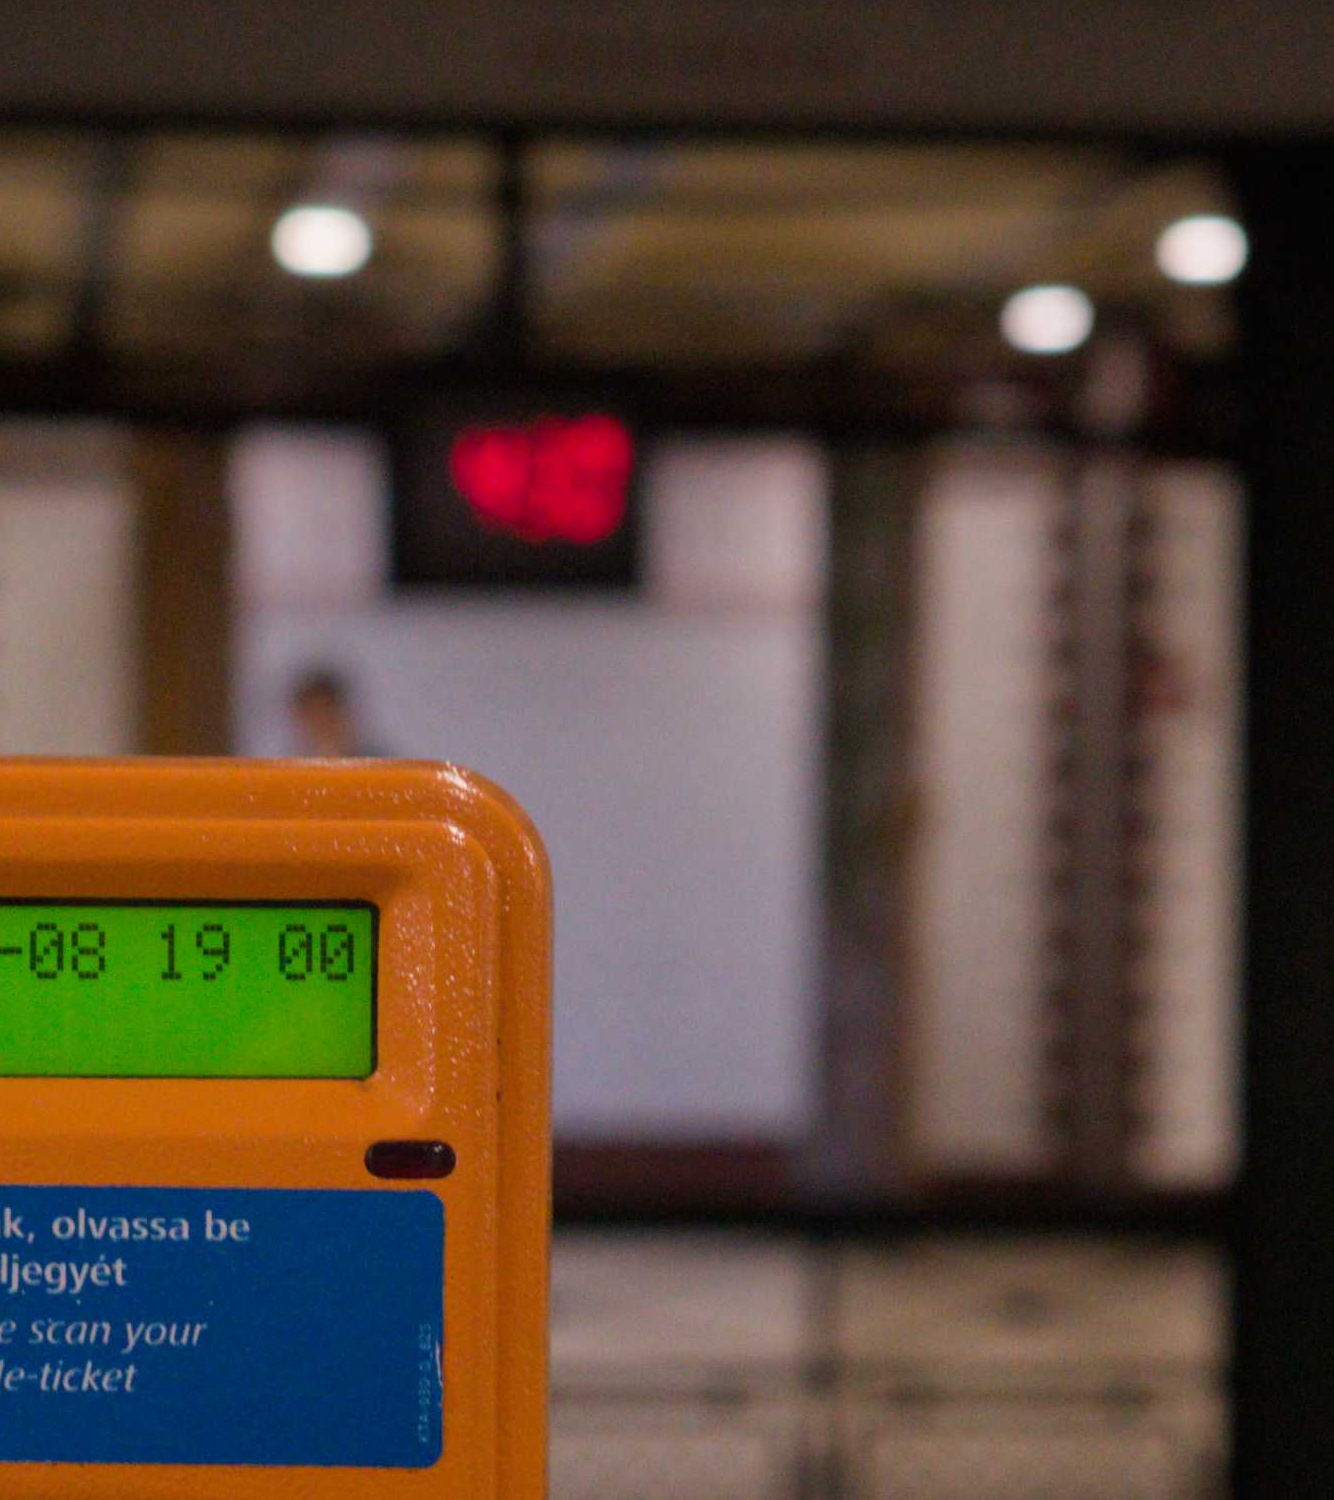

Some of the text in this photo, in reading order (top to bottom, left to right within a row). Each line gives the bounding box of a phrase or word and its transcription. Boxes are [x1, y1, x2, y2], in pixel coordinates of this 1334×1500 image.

[161, 924, 229, 980] 19
[279, 924, 354, 981] 00
[52, 1208, 189, 1241] olvassa
[205, 1209, 251, 1241] be
[28, 1319, 112, 1345] scan
[121, 1322, 208, 1353] your
